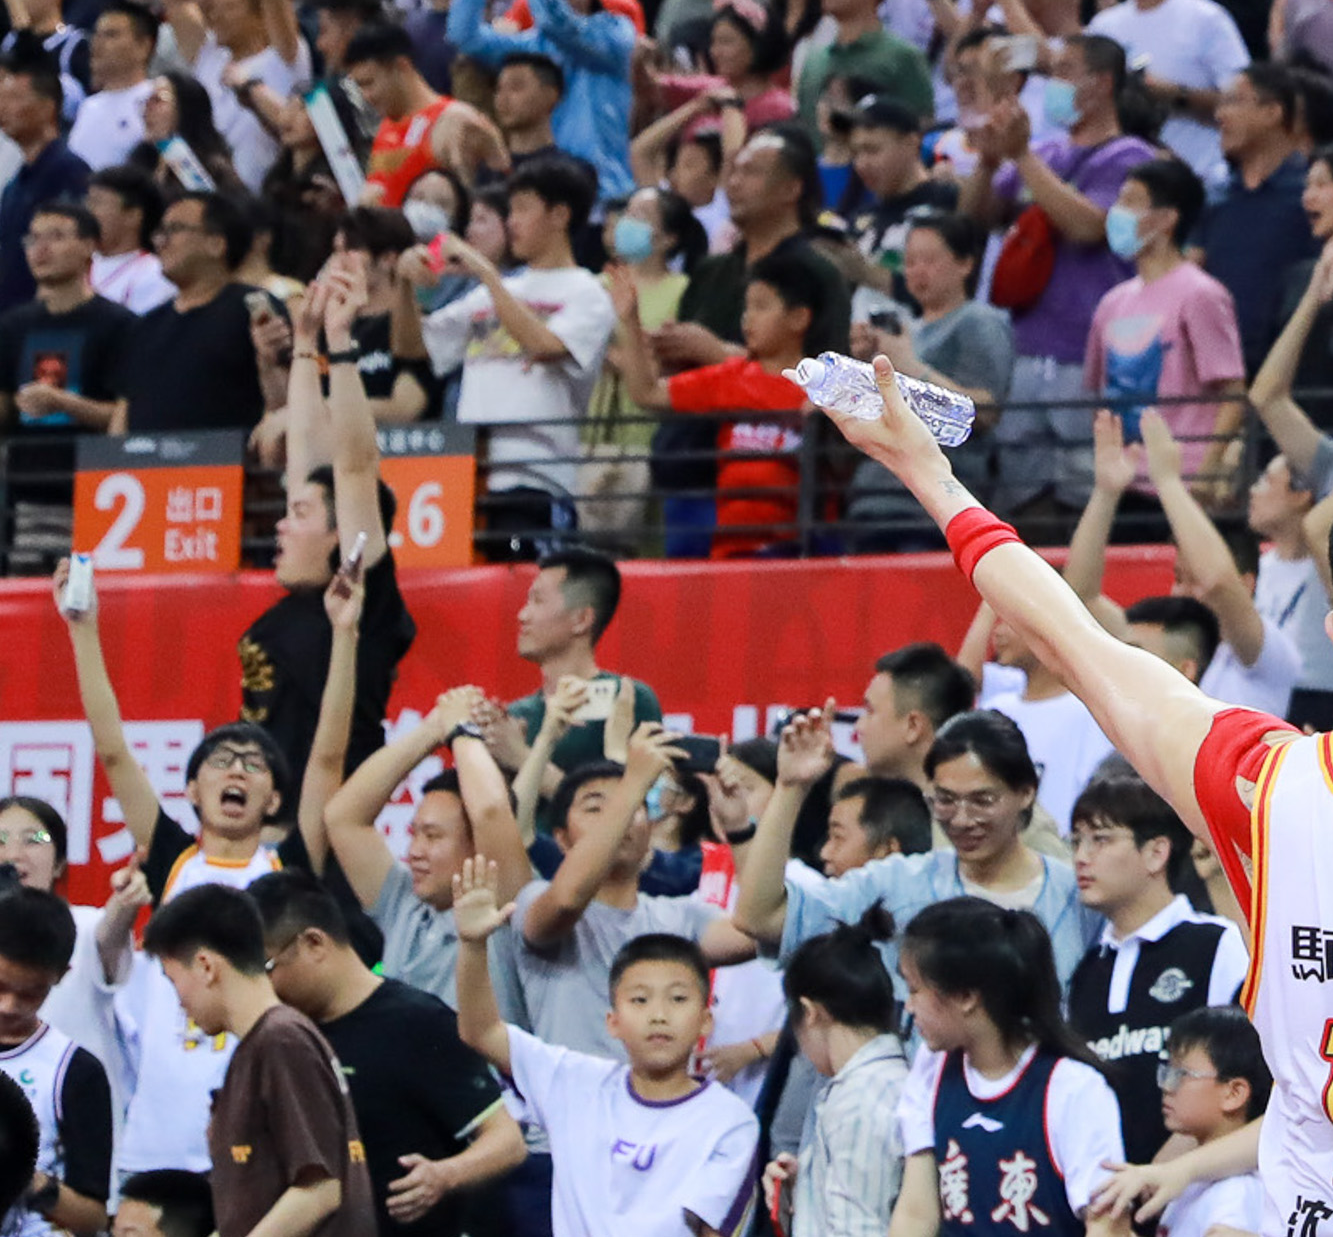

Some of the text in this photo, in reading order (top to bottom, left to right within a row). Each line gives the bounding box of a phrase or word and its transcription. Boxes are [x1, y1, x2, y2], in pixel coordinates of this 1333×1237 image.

[95, 473, 146, 569] 2
[166, 487, 222, 523] 出口
[164, 528, 218, 561] Exit
